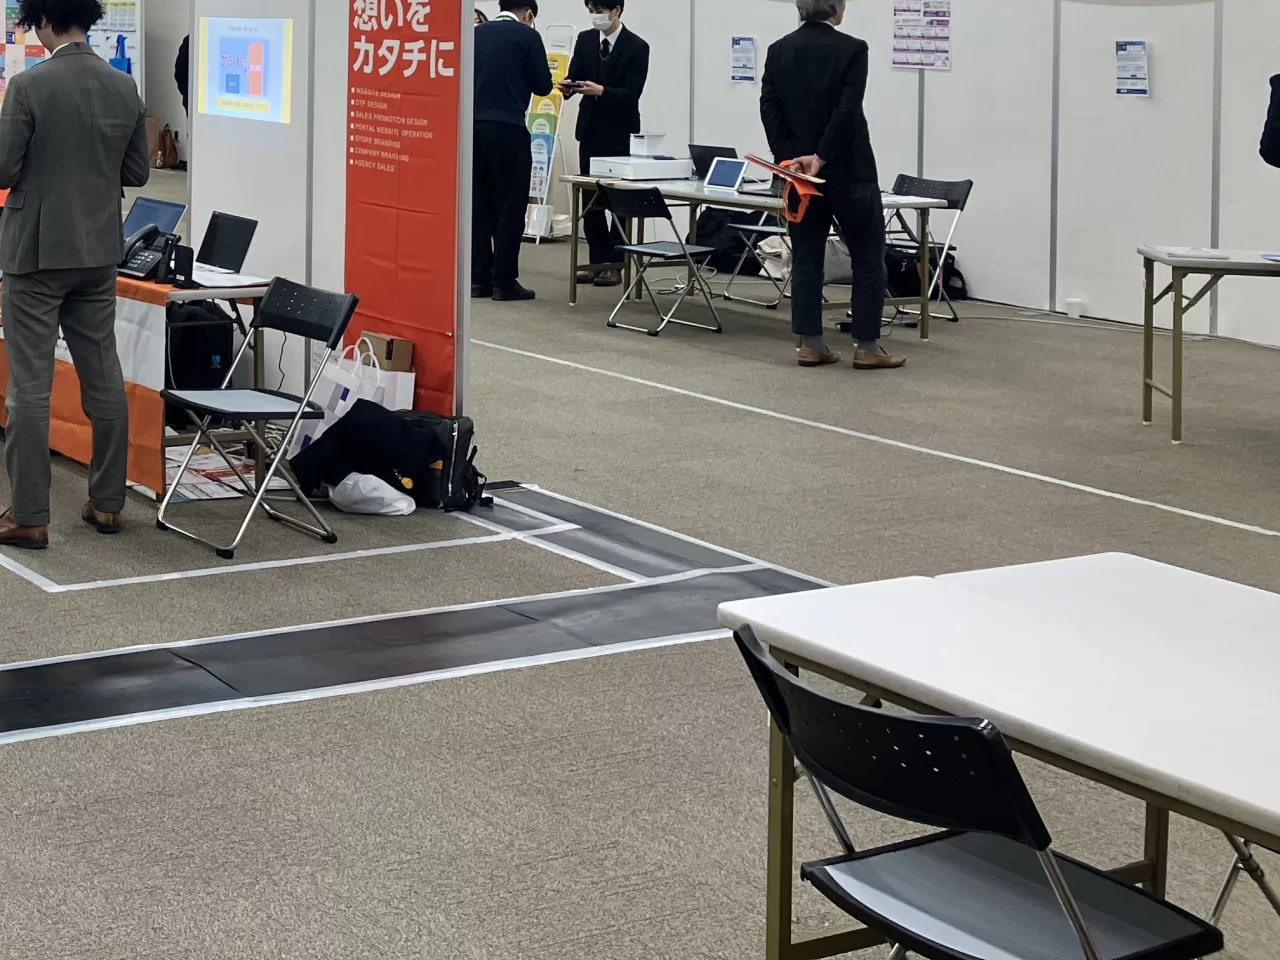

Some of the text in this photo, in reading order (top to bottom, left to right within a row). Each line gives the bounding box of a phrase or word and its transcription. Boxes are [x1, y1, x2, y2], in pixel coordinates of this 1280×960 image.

[352, 35, 455, 78] カタチに
[355, 99, 388, 110] DTP DESIGN
[355, 110, 373, 120] SALES
[406, 117, 428, 126] DESIGN
[355, 122, 376, 133] PORTAL
[401, 129, 434, 139] OPERATION
[354, 146, 380, 157] COMPANY
[354, 158, 376, 169] AGENCY
